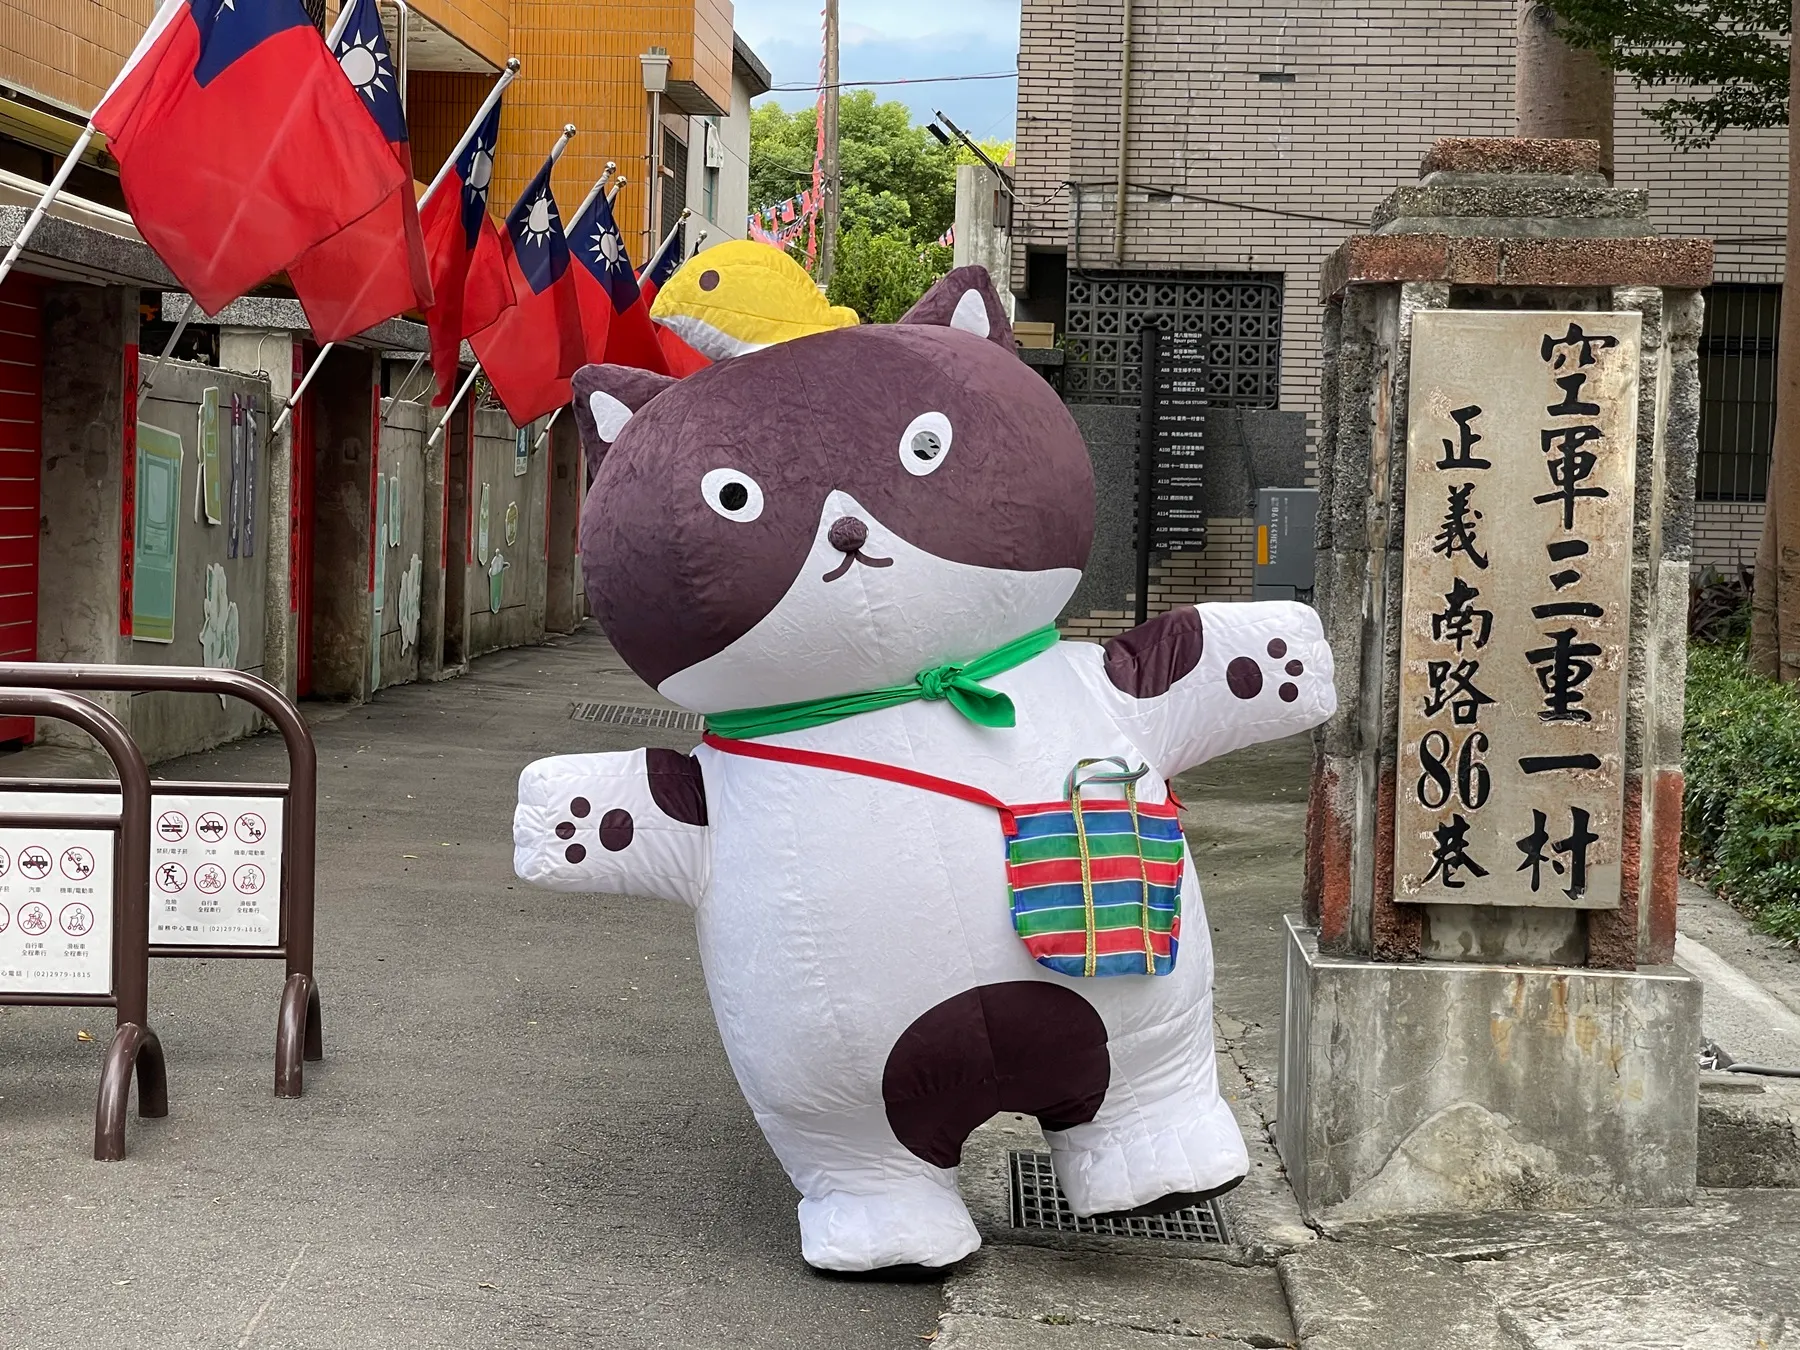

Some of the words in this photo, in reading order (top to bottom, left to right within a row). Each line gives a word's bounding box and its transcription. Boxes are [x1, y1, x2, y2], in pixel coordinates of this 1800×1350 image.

[1416, 404, 1497, 889] 正義南路86巷
[1516, 322, 1620, 901] 空軍三重一村
